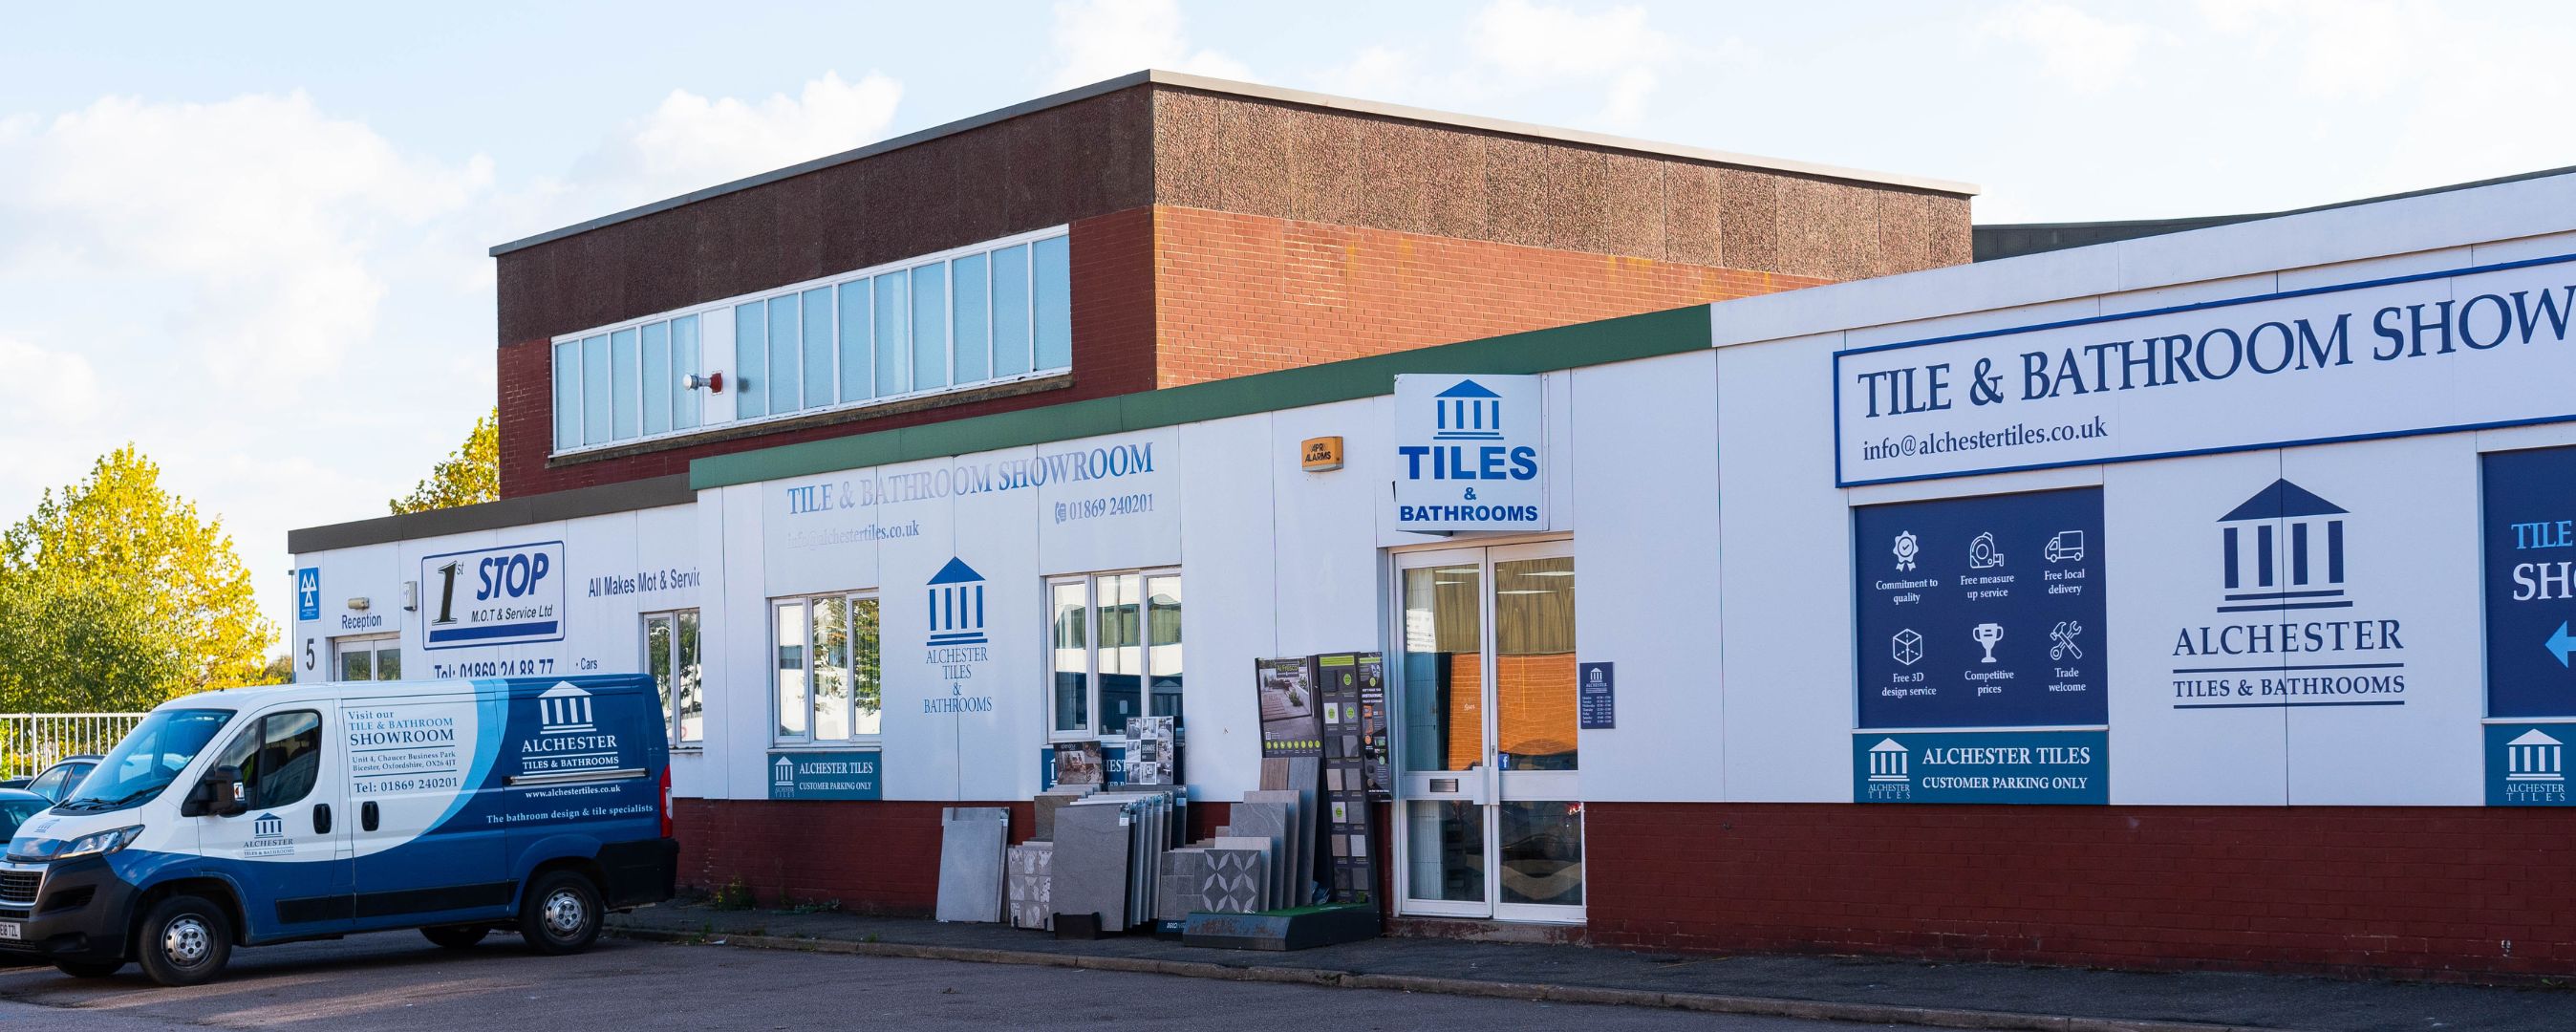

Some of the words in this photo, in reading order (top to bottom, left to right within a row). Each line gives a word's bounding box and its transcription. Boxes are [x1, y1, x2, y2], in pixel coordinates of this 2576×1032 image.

[1857, 363, 1952, 419] TILE
[1969, 357, 2004, 406] &
[2020, 312, 2353, 401] BATHROOM
[2372, 286, 2576, 360] SHOW
[1863, 416, 2108, 461] info@alchestertiles.co.uk
[1305, 451, 1331, 462] ALARMS
[1399, 446, 1537, 481] TILES
[787, 482, 833, 515] TILE
[839, 481, 855, 509] &
[860, 462, 993, 507] BATHROOM
[998, 441, 1154, 491] SHOWROOM
[1464, 486, 1476, 501] &
[1069, 498, 1106, 522] 01869
[1109, 493, 1154, 517] 240201
[1400, 505, 1537, 522] BATHROOMS
[2511, 520, 2573, 549] TILE
[477, 553, 549, 601] STOP
[1960, 575, 1978, 586] Free
[1980, 574, 2014, 584] measure
[2044, 570, 2061, 581] Free
[2064, 569, 2085, 579] local
[589, 576, 601, 597] All
[604, 575, 635, 596] Makes
[638, 571, 657, 592] Mot
[659, 570, 667, 591] &
[1876, 578, 1927, 591] Commitment
[1929, 579, 1938, 589] to
[2049, 584, 2082, 595] delivery
[1893, 591, 1921, 605] quality
[1966, 590, 1978, 600] up
[1980, 588, 2008, 598] service
[471, 609, 495, 623] M.O.T
[497, 609, 504, 621] &
[505, 606, 536, 620] Service
[539, 604, 553, 617] Ltd
[342, 613, 382, 631] Reception
[2172, 619, 2404, 656] ALCHESTER
[306, 637, 315, 671] 5
[925, 647, 988, 664] ALCHESTER
[539, 658, 554, 675] 77
[580, 657, 598, 670] Cars
[942, 665, 972, 680] TILES
[1893, 673, 1909, 683] Free
[1911, 672, 1924, 682] 3D
[1964, 670, 2014, 682] Competitive
[2054, 668, 2079, 678] Trade
[953, 683, 961, 697] &
[1881, 686, 1908, 698] design
[1910, 685, 1937, 696] service
[1977, 684, 2002, 696] prices
[2049, 681, 2086, 692] welcome
[2173, 678, 2230, 698] TILES
[2238, 677, 2253, 697] &
[2261, 675, 2405, 696] BATHROOMS
[923, 696, 993, 713] BATHROOMS
[348, 711, 374, 720] Visit
[349, 722, 374, 731] TILE
[376, 720, 385, 729] &
[389, 718, 453, 728] BATHROOM
[350, 728, 455, 746] SHOWROOM
[522, 735, 617, 753] ALCHESTER
[1922, 748, 2032, 764] ALCHESTER
[2036, 747, 2091, 764] TILES
[382, 762, 424, 770] Oxfordshire,
[523, 760, 548, 770] TILES
[550, 760, 558, 768] &
[561, 756, 619, 767] BATHROOMS
[800, 763, 848, 774] ALCHESTER
[849, 762, 873, 774] TILES
[354, 783, 376, 793] Tel:
[380, 780, 414, 791] 01869
[419, 777, 458, 788] 240201
[800, 782, 829, 790] CUSTOMER
[830, 782, 855, 790] PARKING
[856, 782, 871, 790] ONLY
[1868, 784, 1910, 792] ALCHESTER
[1922, 776, 1989, 789] CUSTOMER
[1992, 777, 2050, 789] PARKING
[2051, 777, 2088, 789] ONLY
[2506, 784, 2565, 793] ALCHESTER
[526, 785, 621, 799] www.alchestertiles.co.uk
[2506, 793, 2565, 802] TILES
[486, 815, 504, 824] The
[506, 812, 547, 823] bathroom
[550, 809, 580, 819] design
[592, 806, 607, 815] tile
[609, 804, 653, 815] specialists
[244, 838, 293, 849] ALCHESTER
